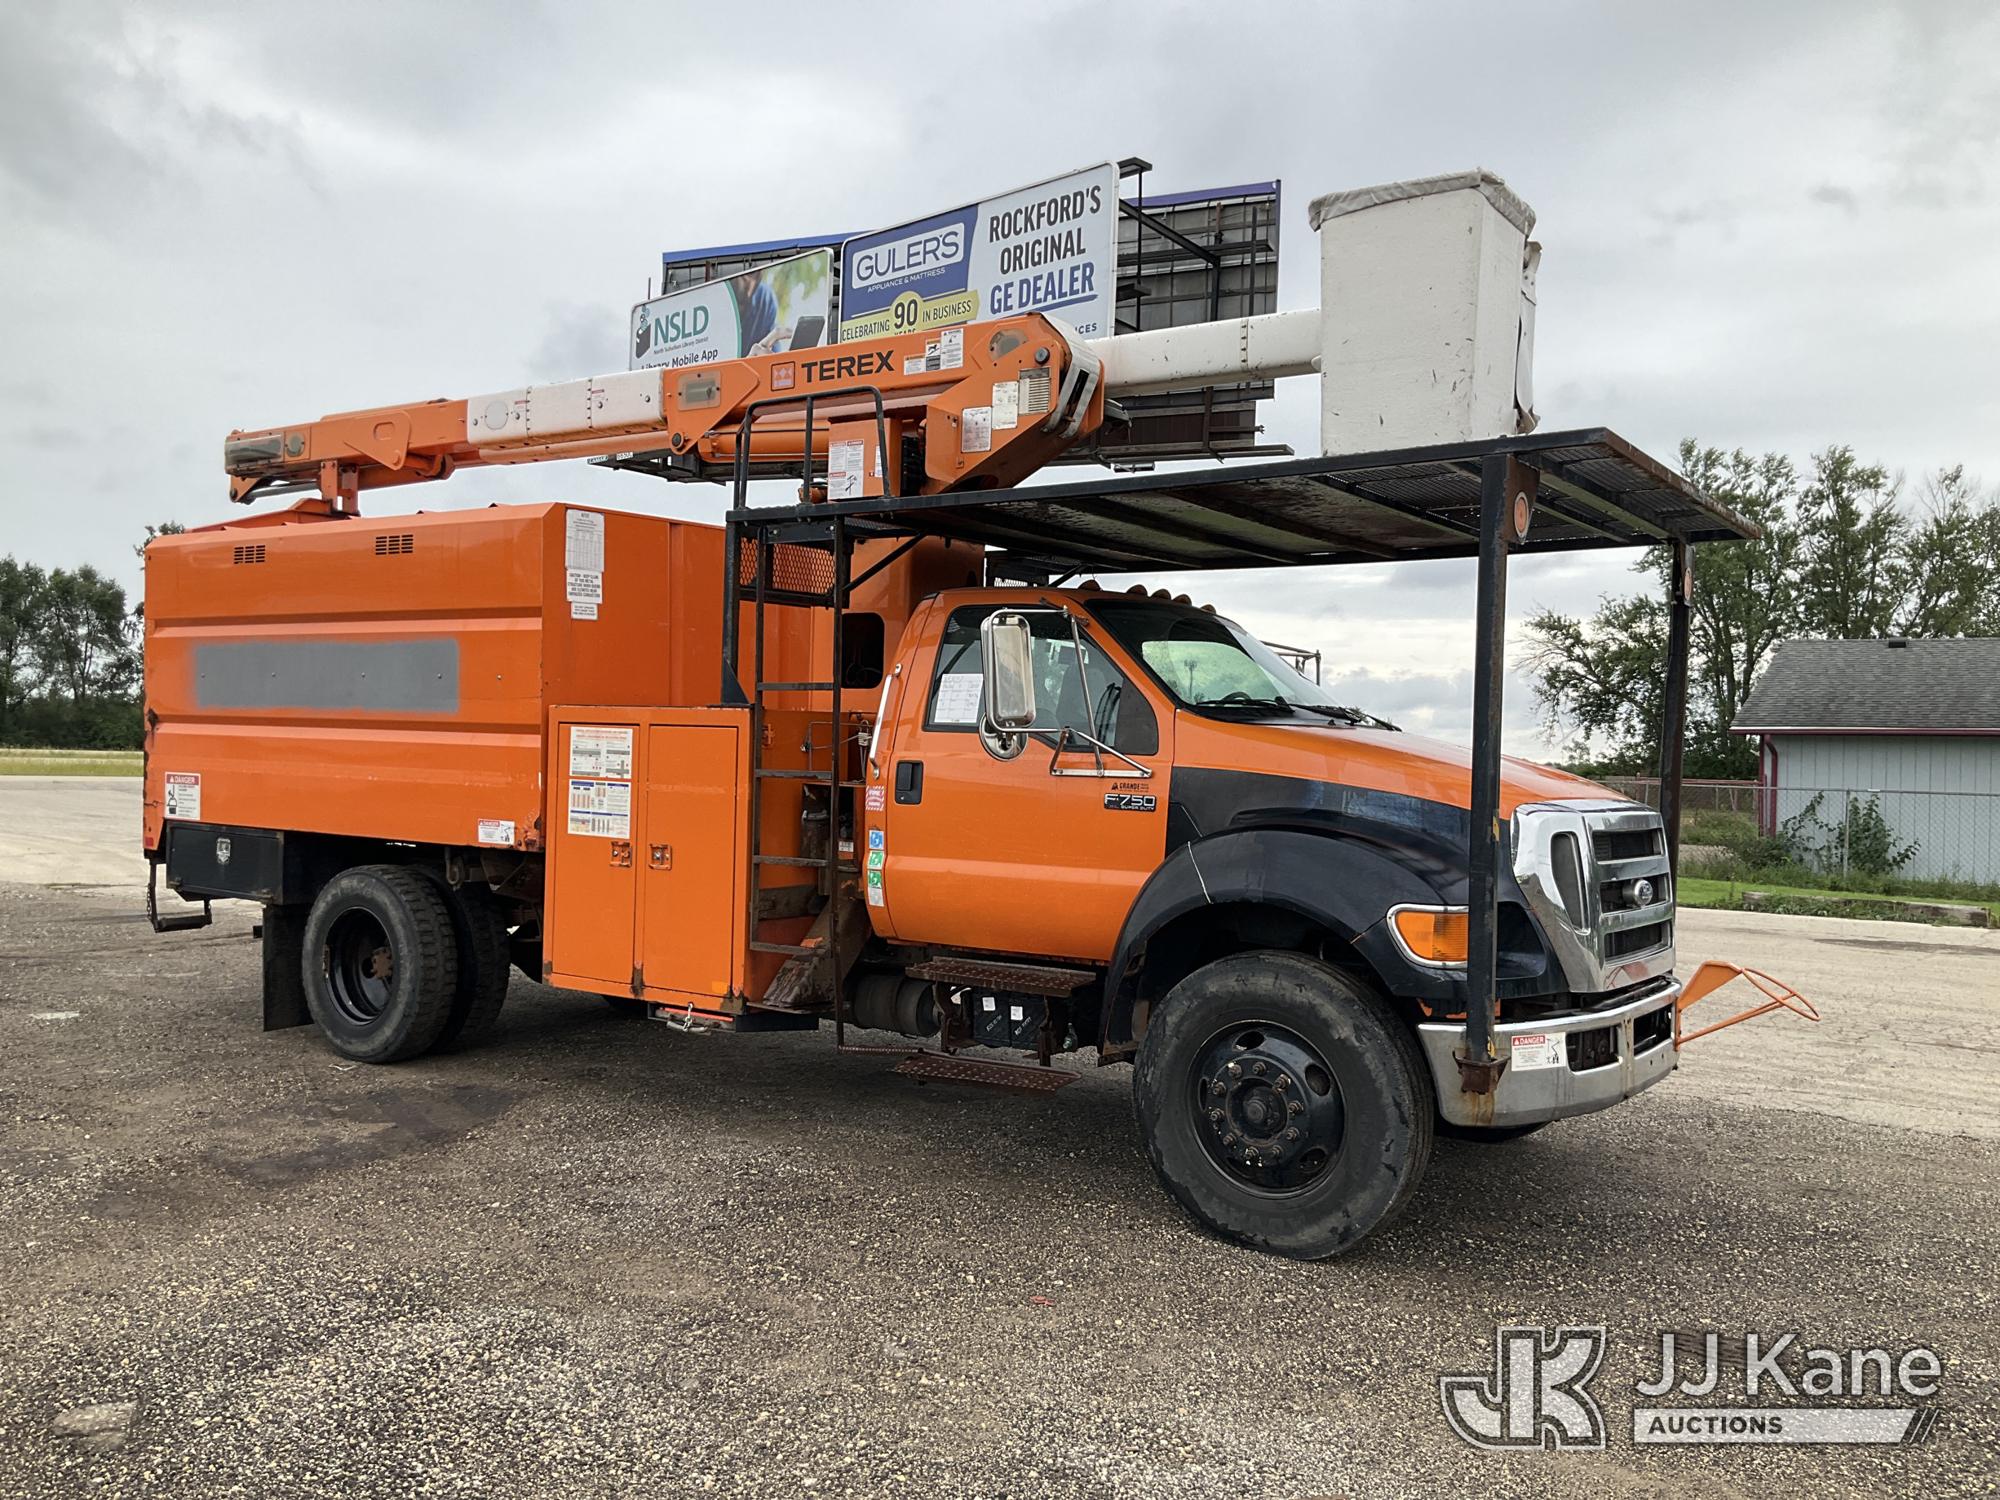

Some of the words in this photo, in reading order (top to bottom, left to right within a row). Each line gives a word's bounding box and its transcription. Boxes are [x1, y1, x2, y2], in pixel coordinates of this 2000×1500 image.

[989, 185, 1102, 243] ROCKFORD'S
[857, 231, 959, 281] GULER'S
[1000, 227, 1086, 275] ORIGINAL
[867, 279, 903, 293] APPLIANCE
[910, 267, 946, 282] MATTRESS
[990, 281, 1014, 315] GE
[1018, 262, 1095, 309] DEALER
[654, 305, 709, 346] NSLD
[841, 319, 890, 341] CELEBRATING
[894, 299, 918, 329] 90
[922, 311, 931, 322] IN
[933, 300, 972, 320] BUSINESS
[1075, 322, 1097, 334] CES
[672, 353, 699, 368] Mobile
[701, 349, 718, 361] App
[801, 350, 894, 383] TEREX
[1520, 1036, 1544, 1044] DANGER
